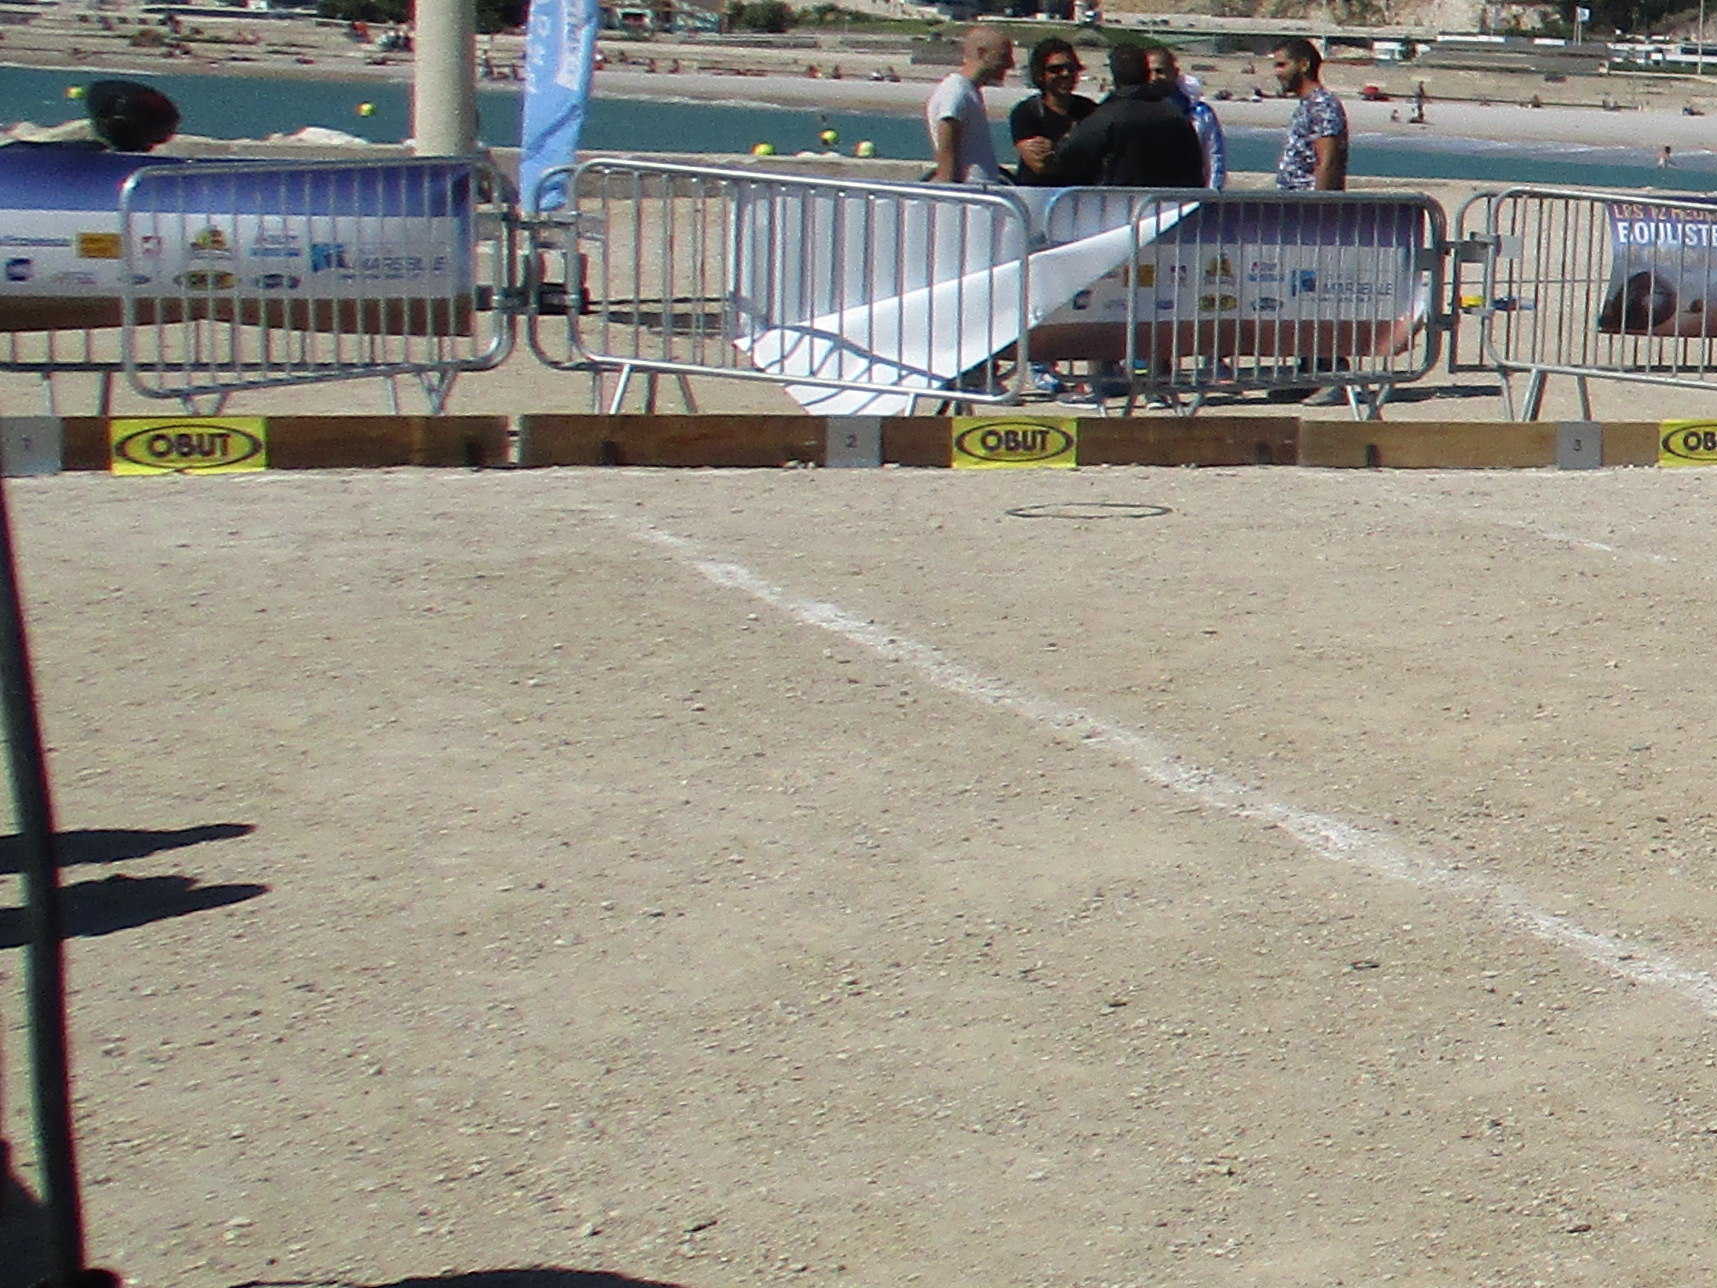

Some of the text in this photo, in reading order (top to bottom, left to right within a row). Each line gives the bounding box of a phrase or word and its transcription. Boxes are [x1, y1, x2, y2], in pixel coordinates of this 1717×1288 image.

[150, 433, 231, 458] OBUT
[845, 434, 859, 448] 2
[981, 429, 1051, 452] OBUT
